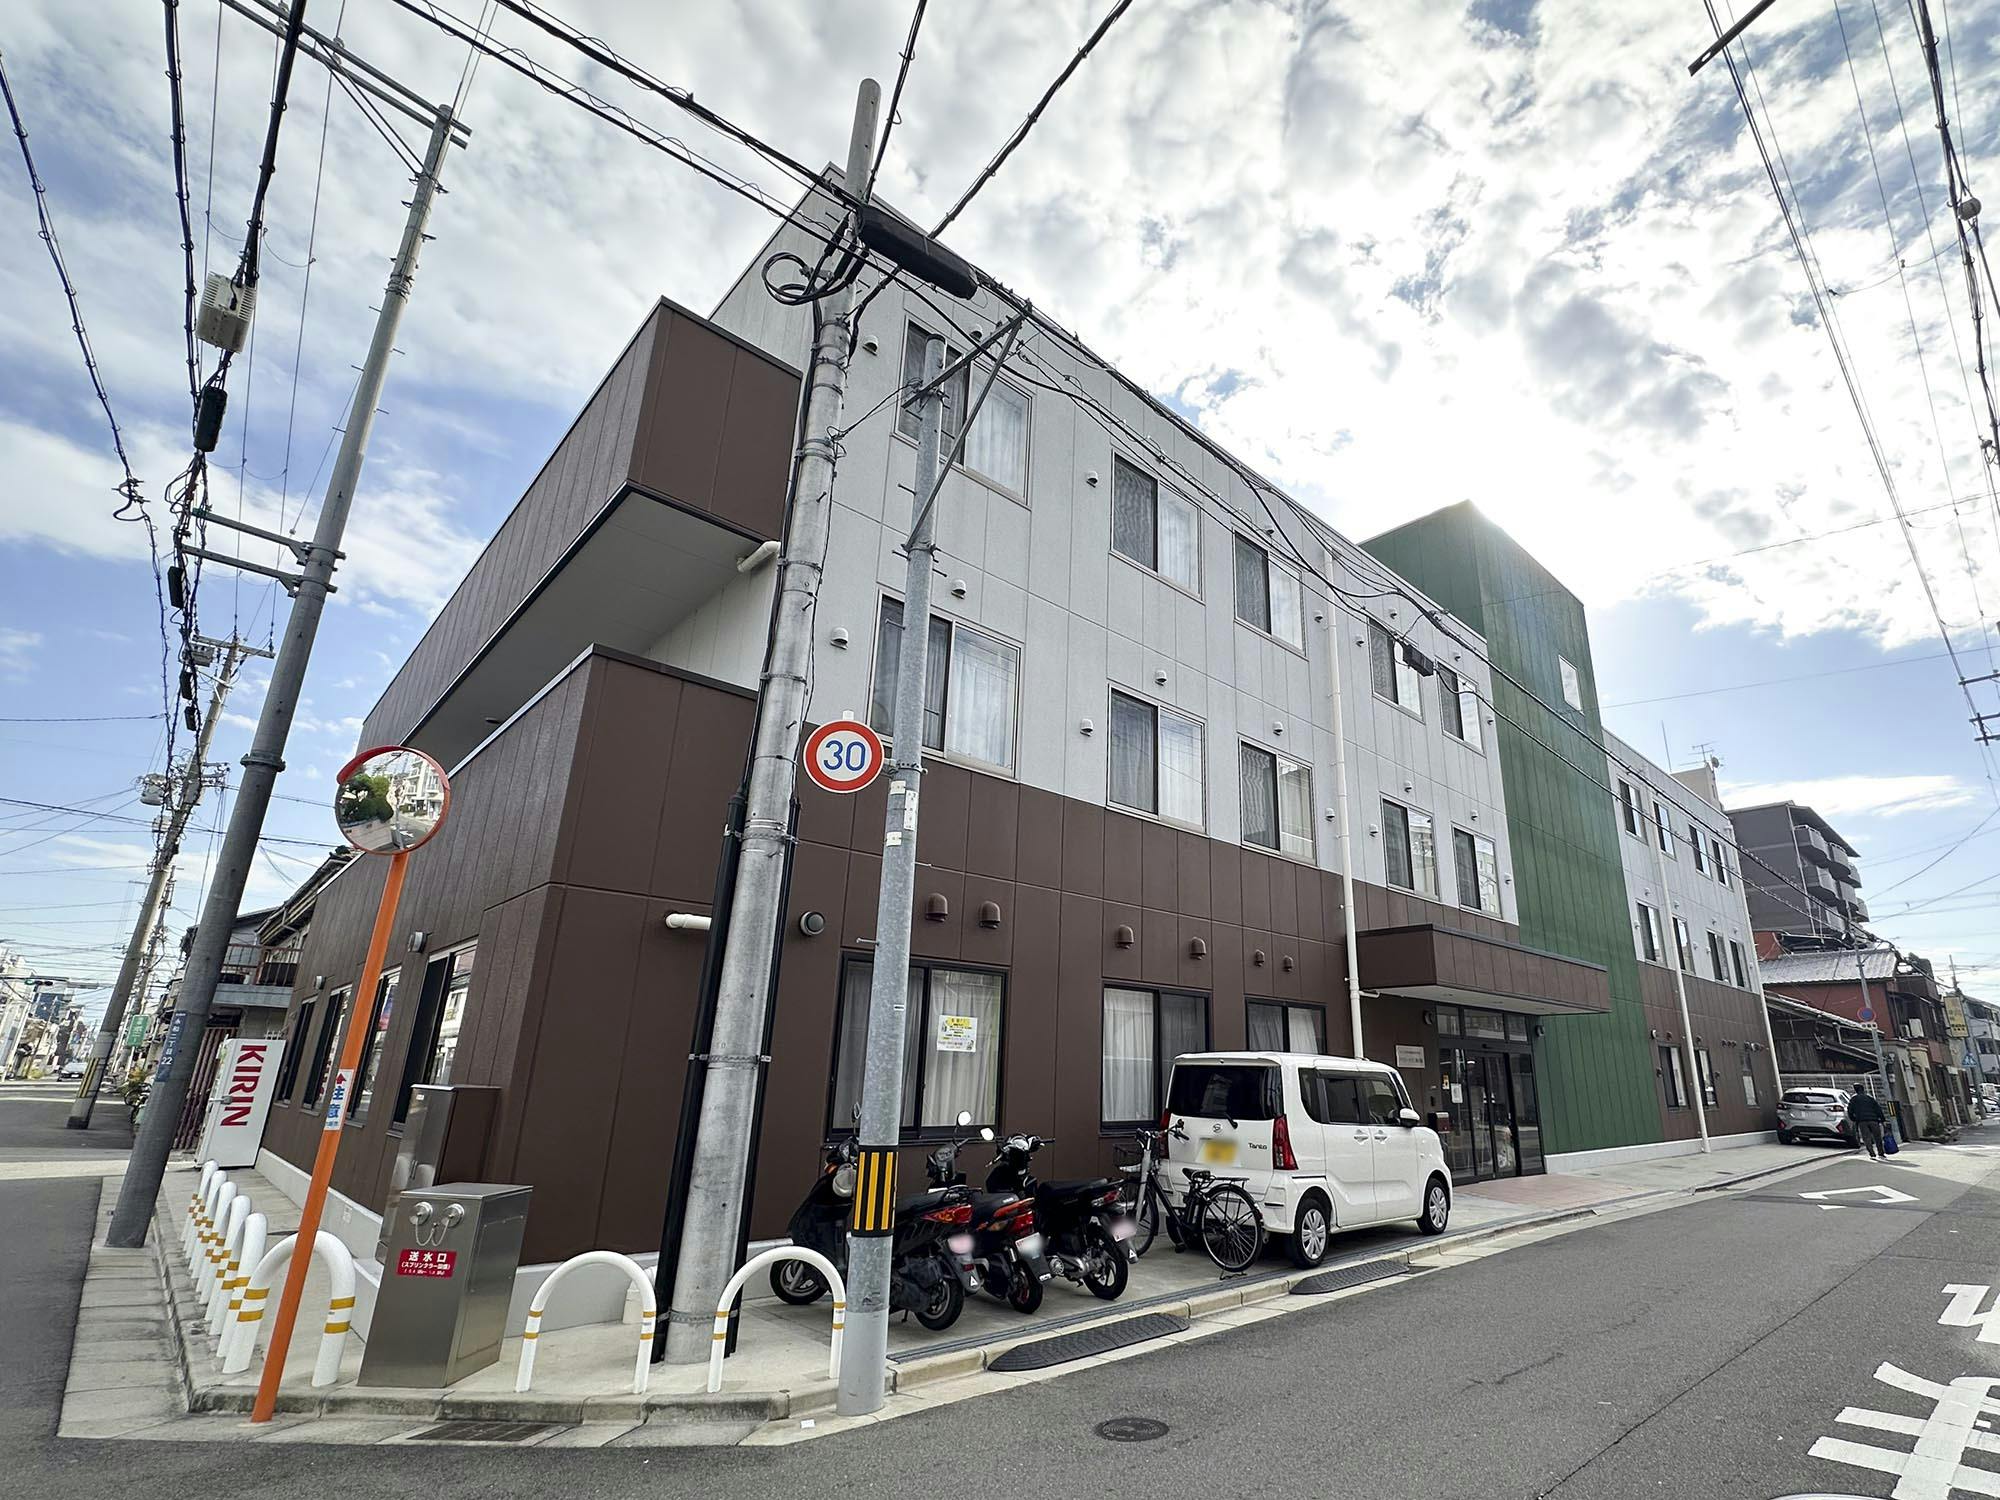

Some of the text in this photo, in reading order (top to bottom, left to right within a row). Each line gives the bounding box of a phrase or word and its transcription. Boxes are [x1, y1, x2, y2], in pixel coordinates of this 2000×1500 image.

[824, 740, 865, 771] 30
[161, 1056, 173, 1065] 22
[220, 1045, 267, 1126] KIRIN
[408, 1250, 448, 1263] 送水口
